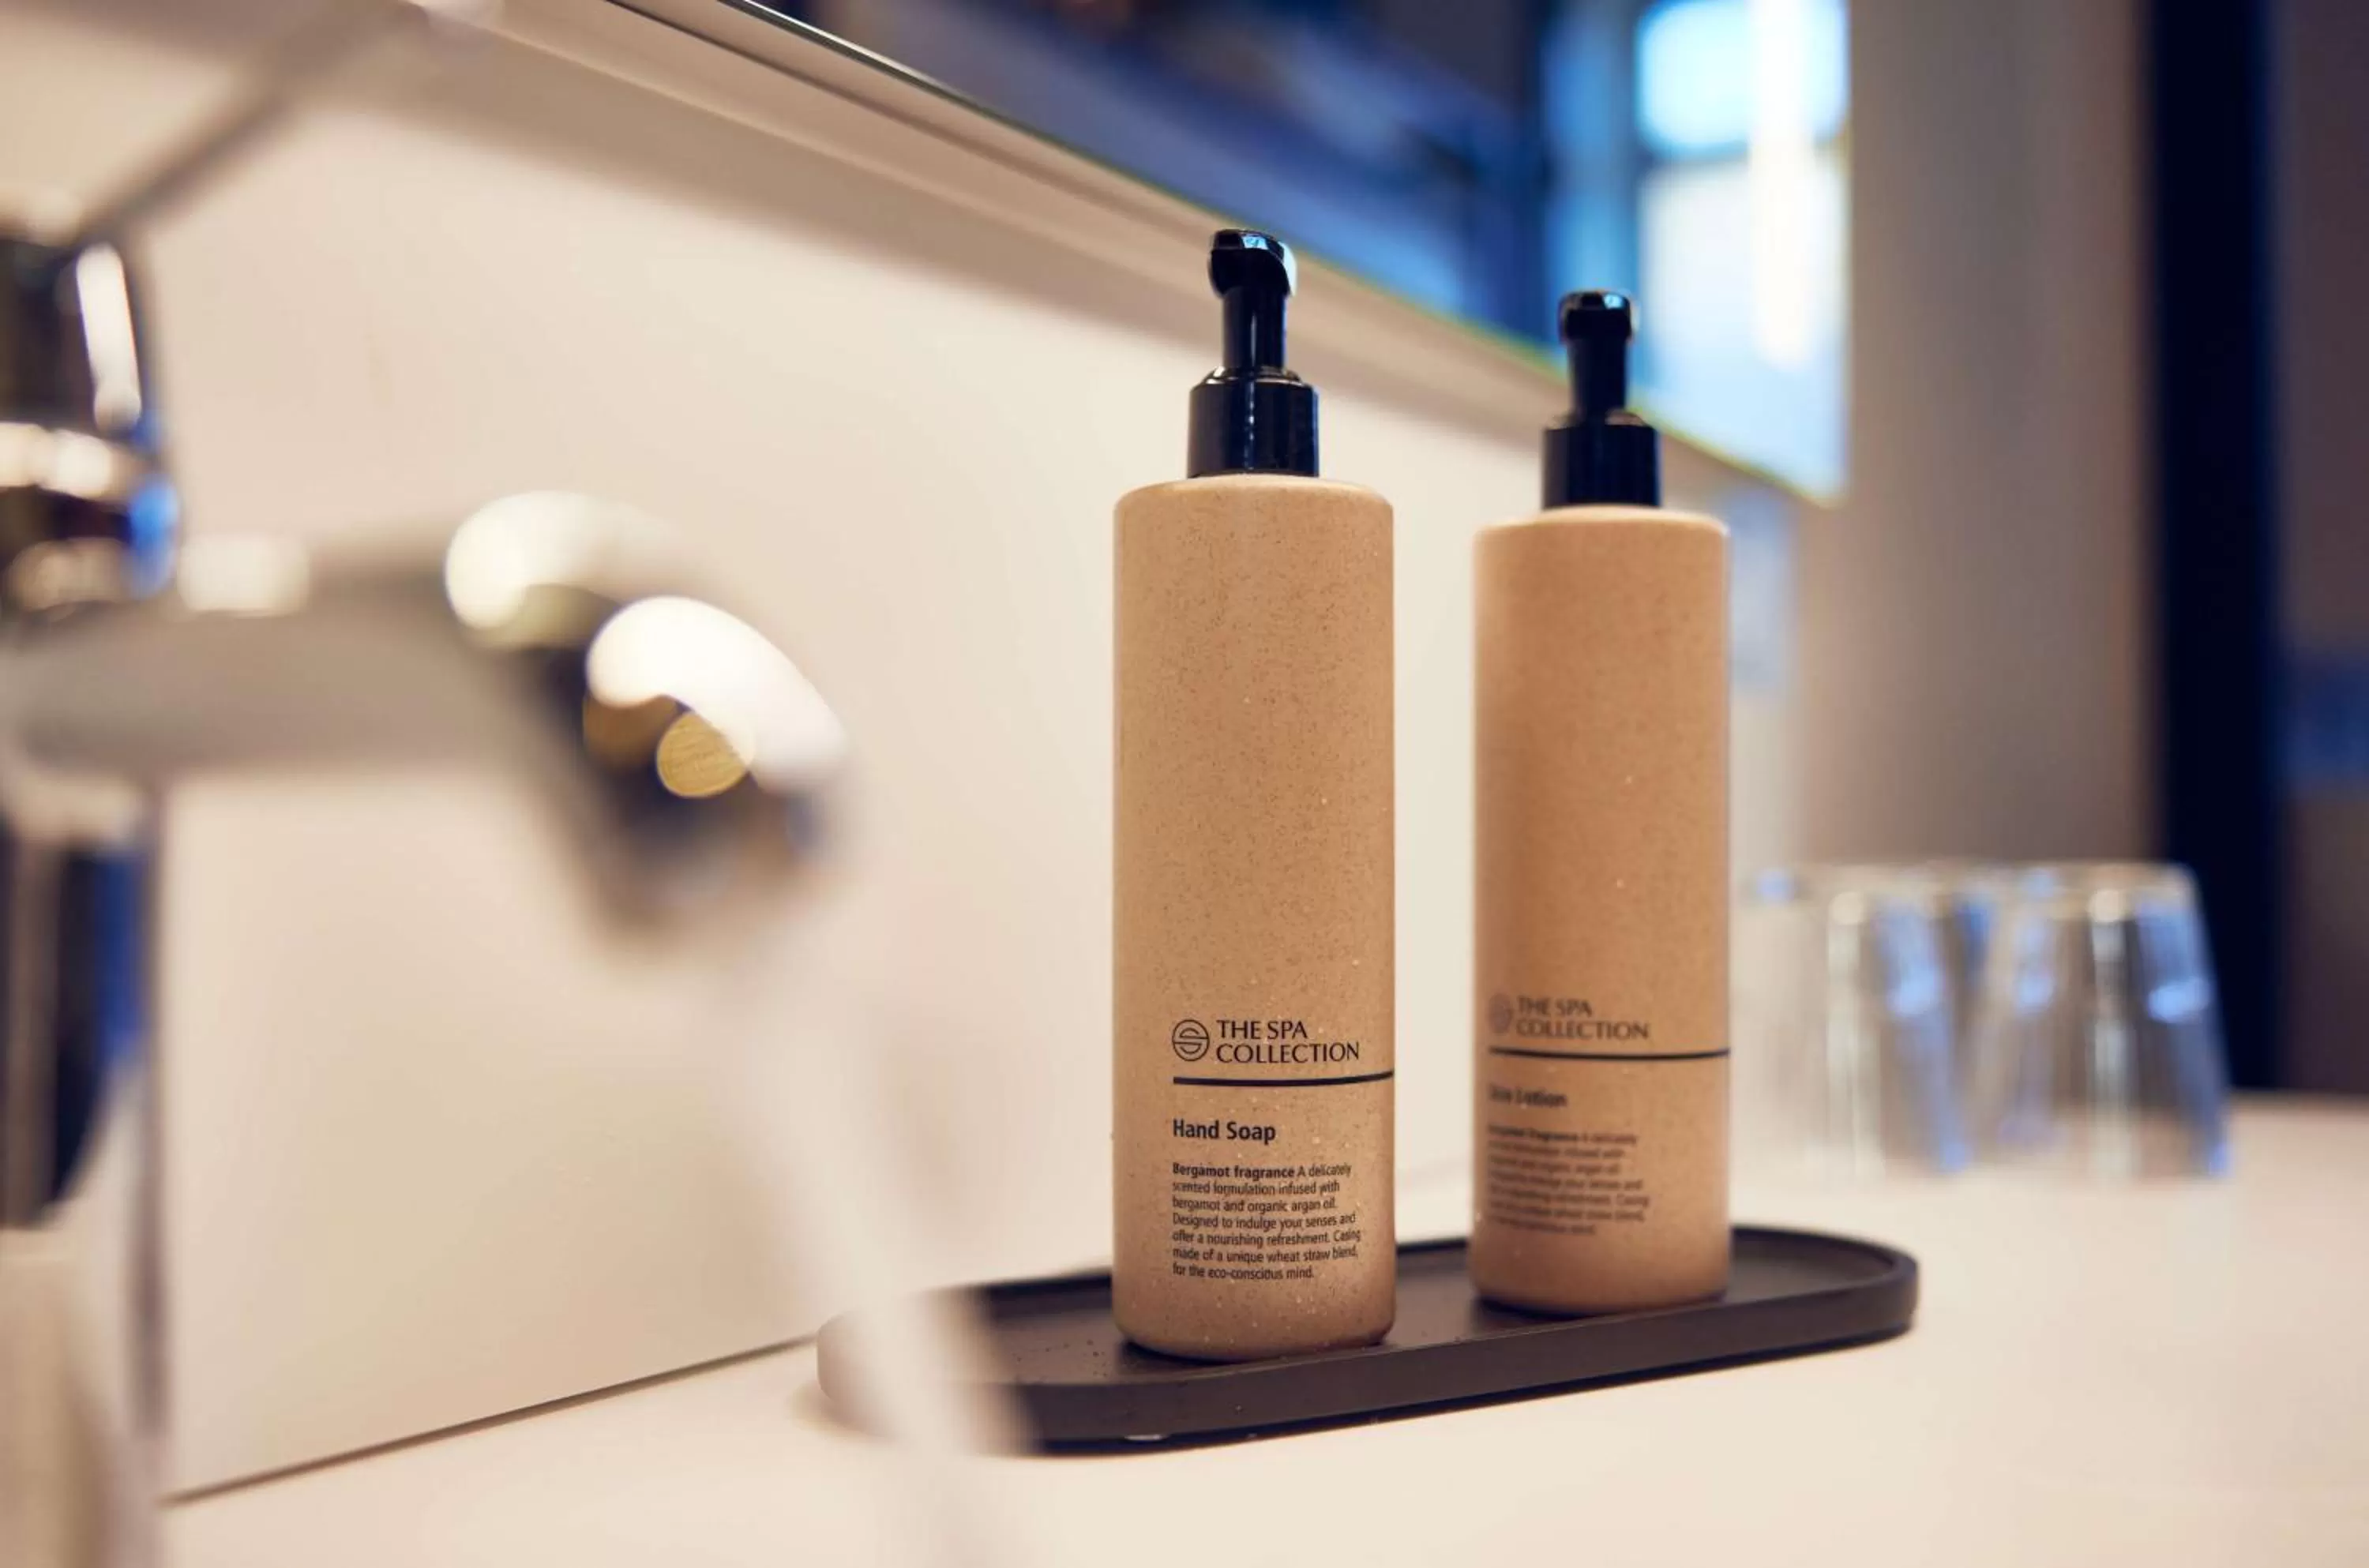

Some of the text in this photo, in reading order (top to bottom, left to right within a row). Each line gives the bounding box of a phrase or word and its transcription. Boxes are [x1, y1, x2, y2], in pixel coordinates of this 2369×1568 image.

[1517, 995, 1593, 1018] THE SPA
[1216, 1020, 1308, 1040] THE SPA
[1515, 1018, 1650, 1041] COLLECTION
[1216, 1042, 1360, 1064] COLLECTION
[1173, 1119, 1276, 1144] Hand Soap
[1173, 1162, 1352, 1181] Bergamot fragrance A delicately
[1173, 1180, 1340, 1195] scented formulation infused with
[1173, 1196, 1336, 1214] bergamot and organic argan oil.
[1173, 1211, 1356, 1236] Designed to indulge your senses and
[1173, 1229, 1361, 1249] offer a nourishing refreshment. Casing
[1173, 1247, 1200, 1260] made
[1203, 1249, 1214, 1260] of
[1217, 1251, 1222, 1261] a
[1226, 1251, 1263, 1266] unique
[1266, 1251, 1300, 1262] wheat
[1303, 1249, 1331, 1261] straw
[1173, 1262, 1314, 1280] for the eco-conscious mind.
